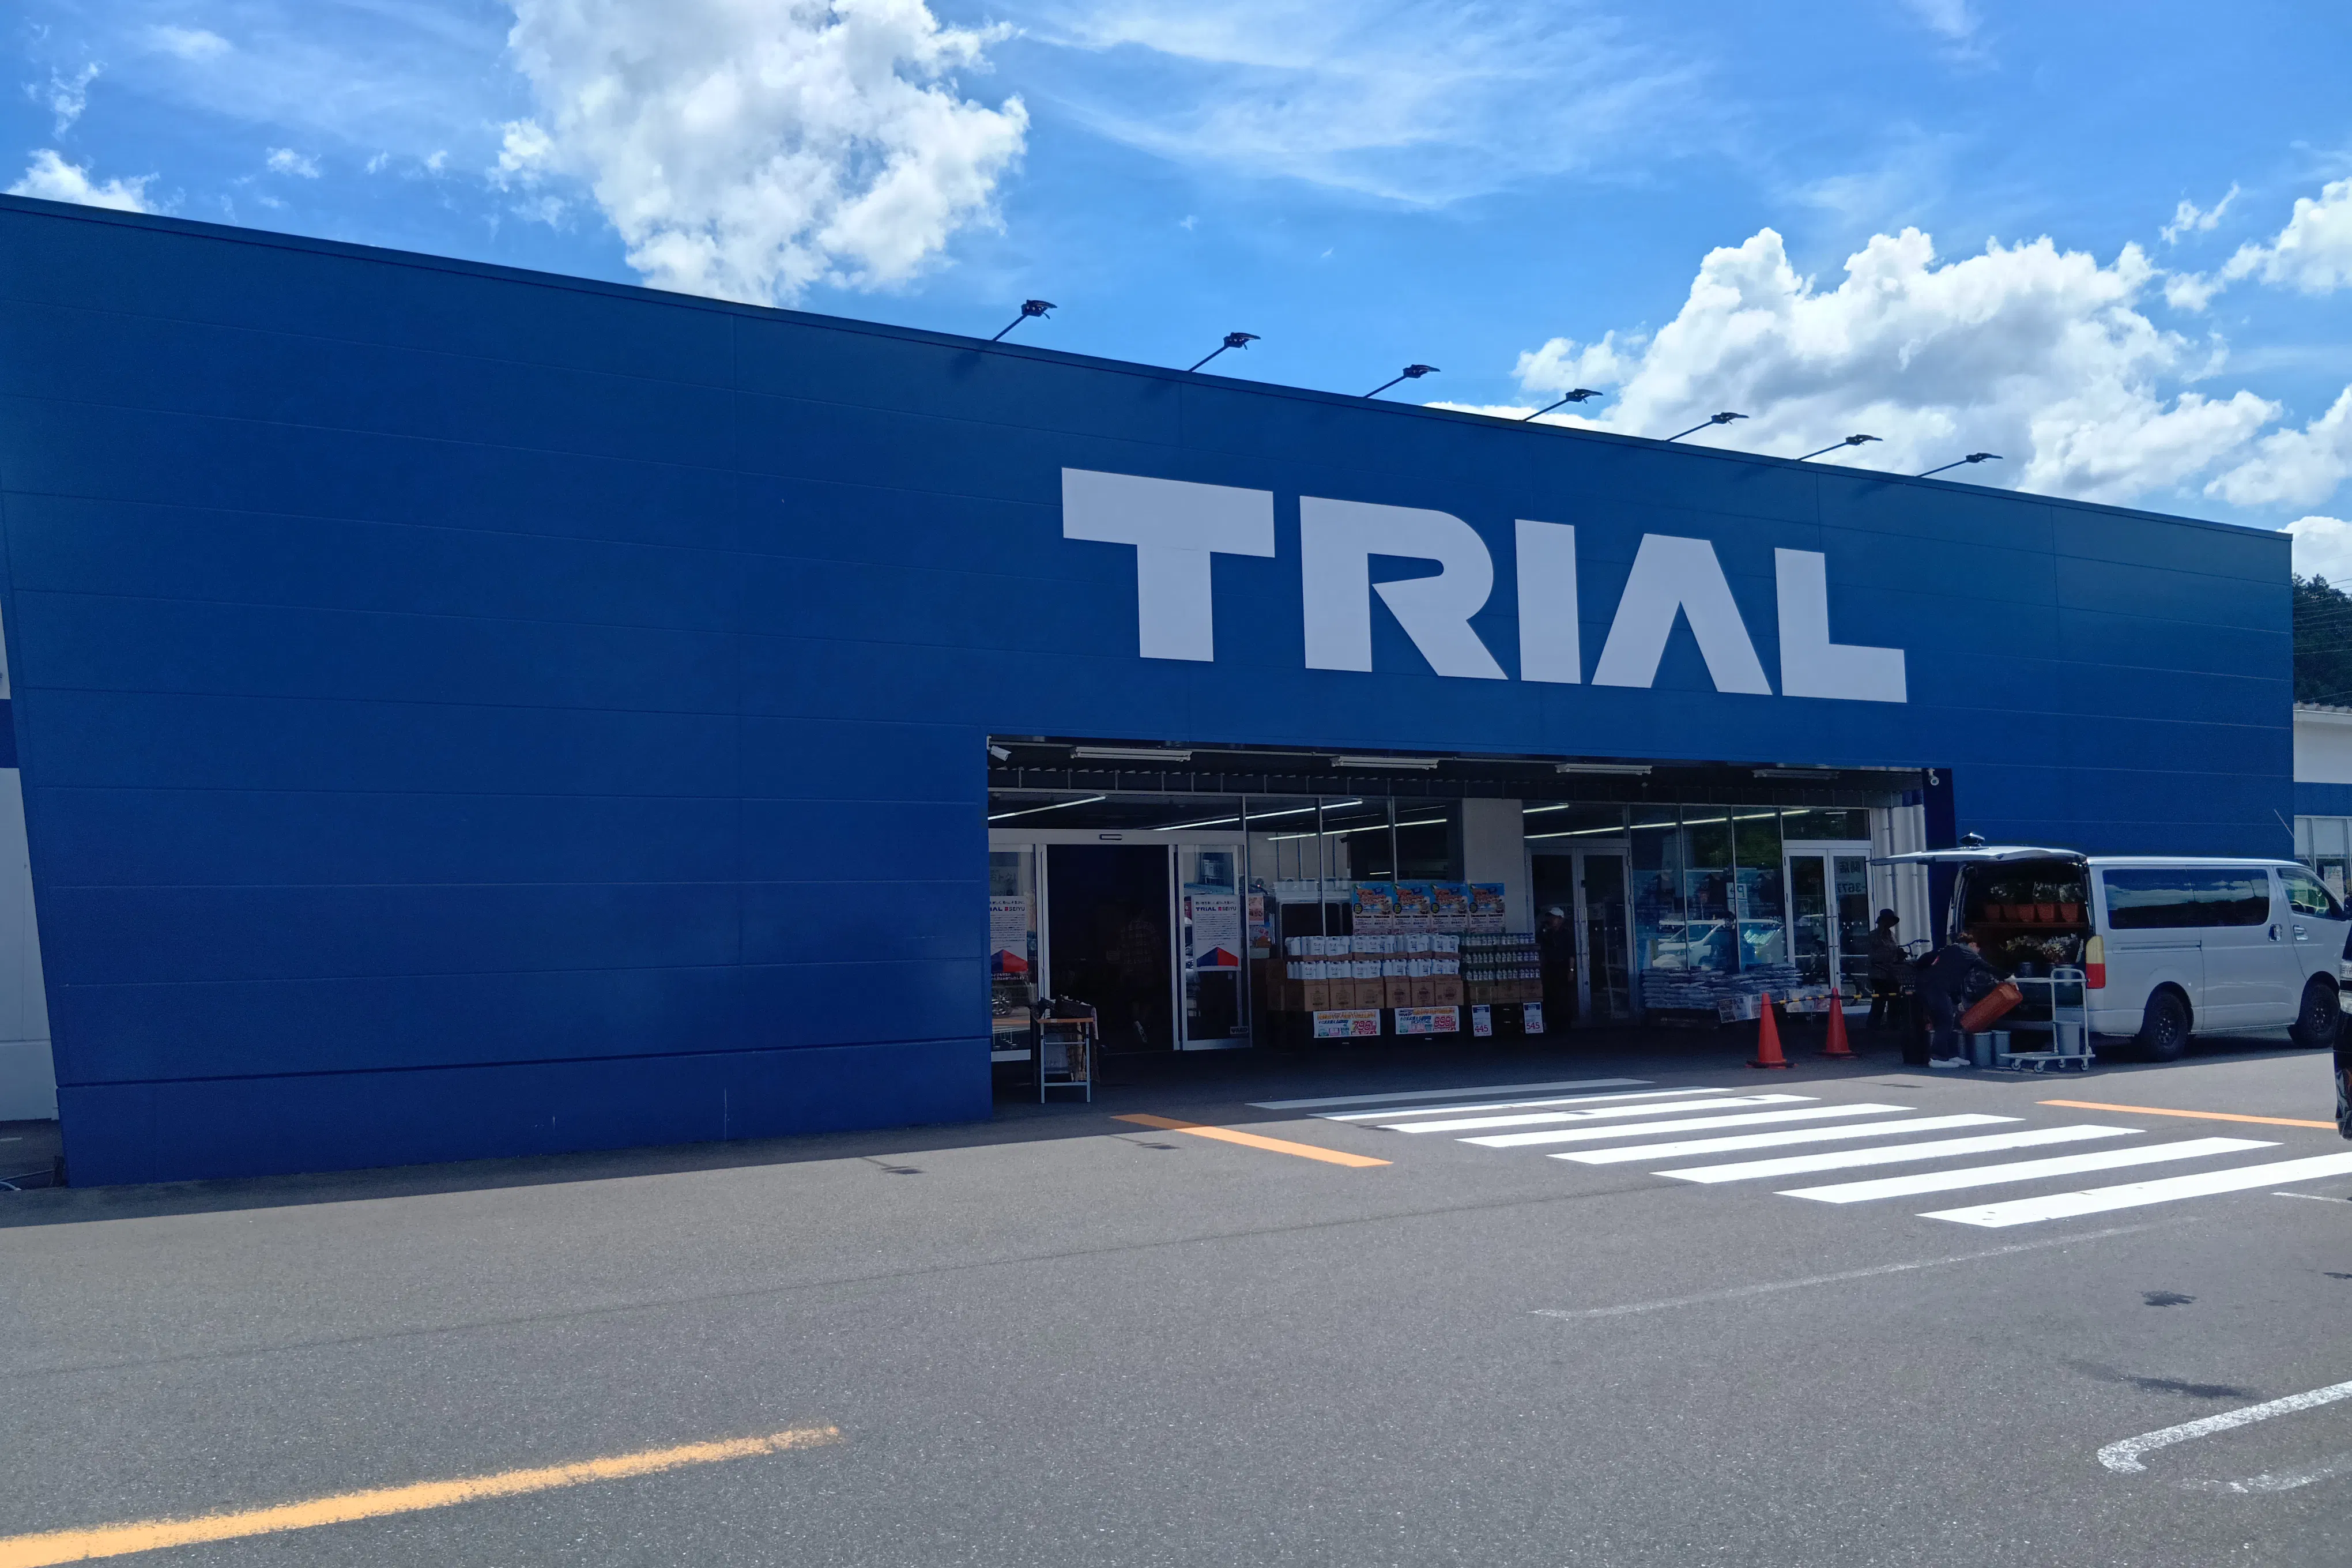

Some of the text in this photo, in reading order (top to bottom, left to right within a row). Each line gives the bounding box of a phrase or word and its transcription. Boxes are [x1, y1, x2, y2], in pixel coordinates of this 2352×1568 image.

[1061, 467, 1908, 703] TRIAL
[1475, 1024, 1488, 1032] 445
[1526, 1022, 1540, 1030] 545
